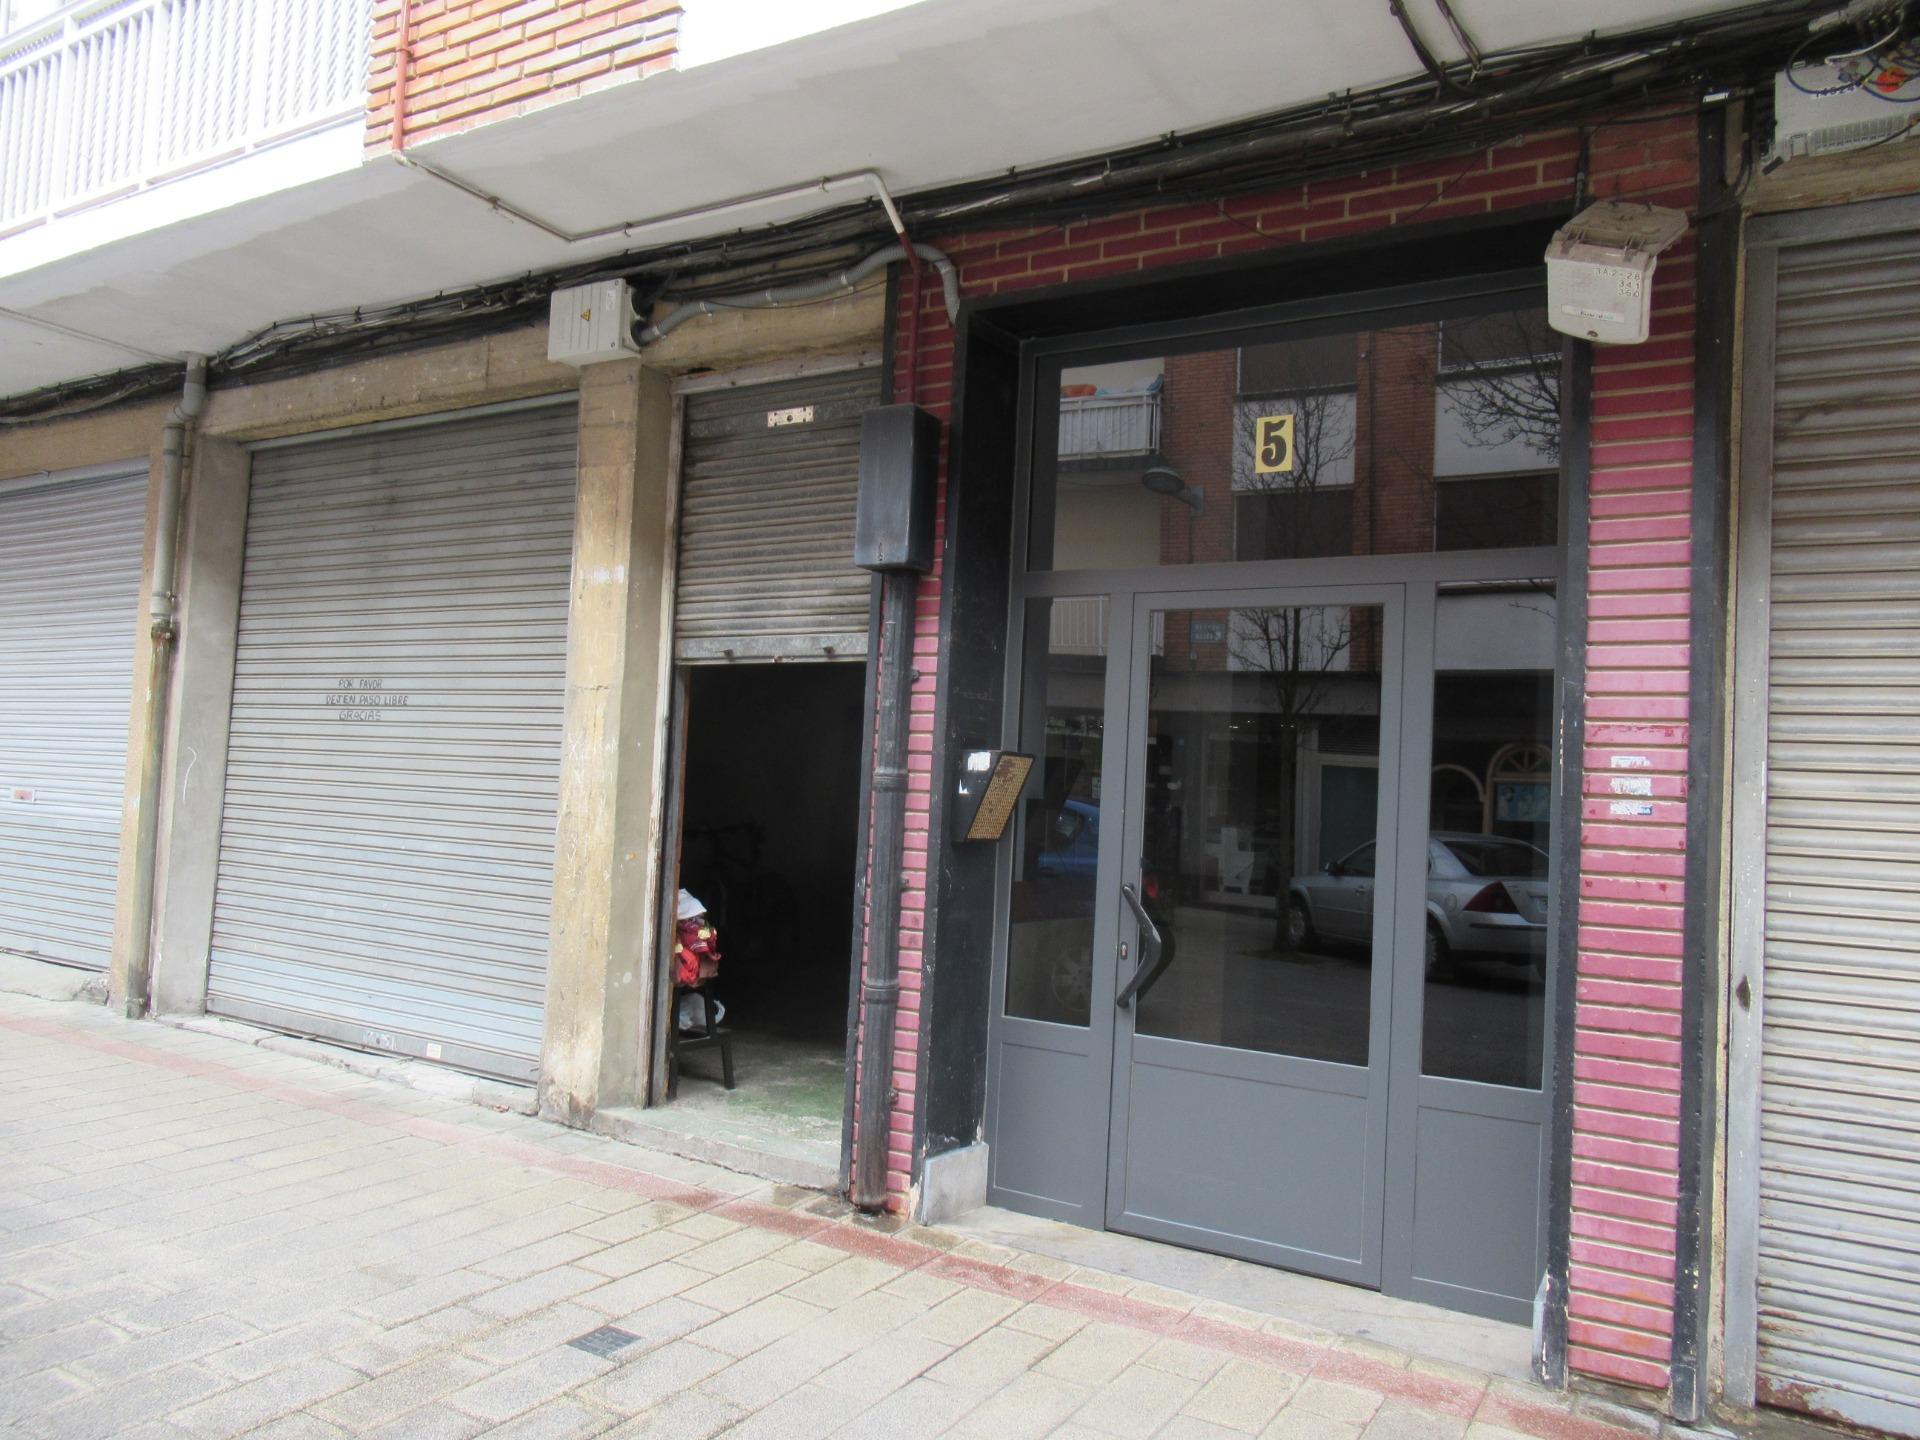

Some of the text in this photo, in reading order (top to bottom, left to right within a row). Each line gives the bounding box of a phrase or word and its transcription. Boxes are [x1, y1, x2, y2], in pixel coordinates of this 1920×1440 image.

[1261, 419, 1287, 468] 5
[338, 679, 383, 690] POR FAVOR
[326, 695, 409, 706] DEJEN PASO LIBRE
[338, 710, 382, 721] GRACIAS
